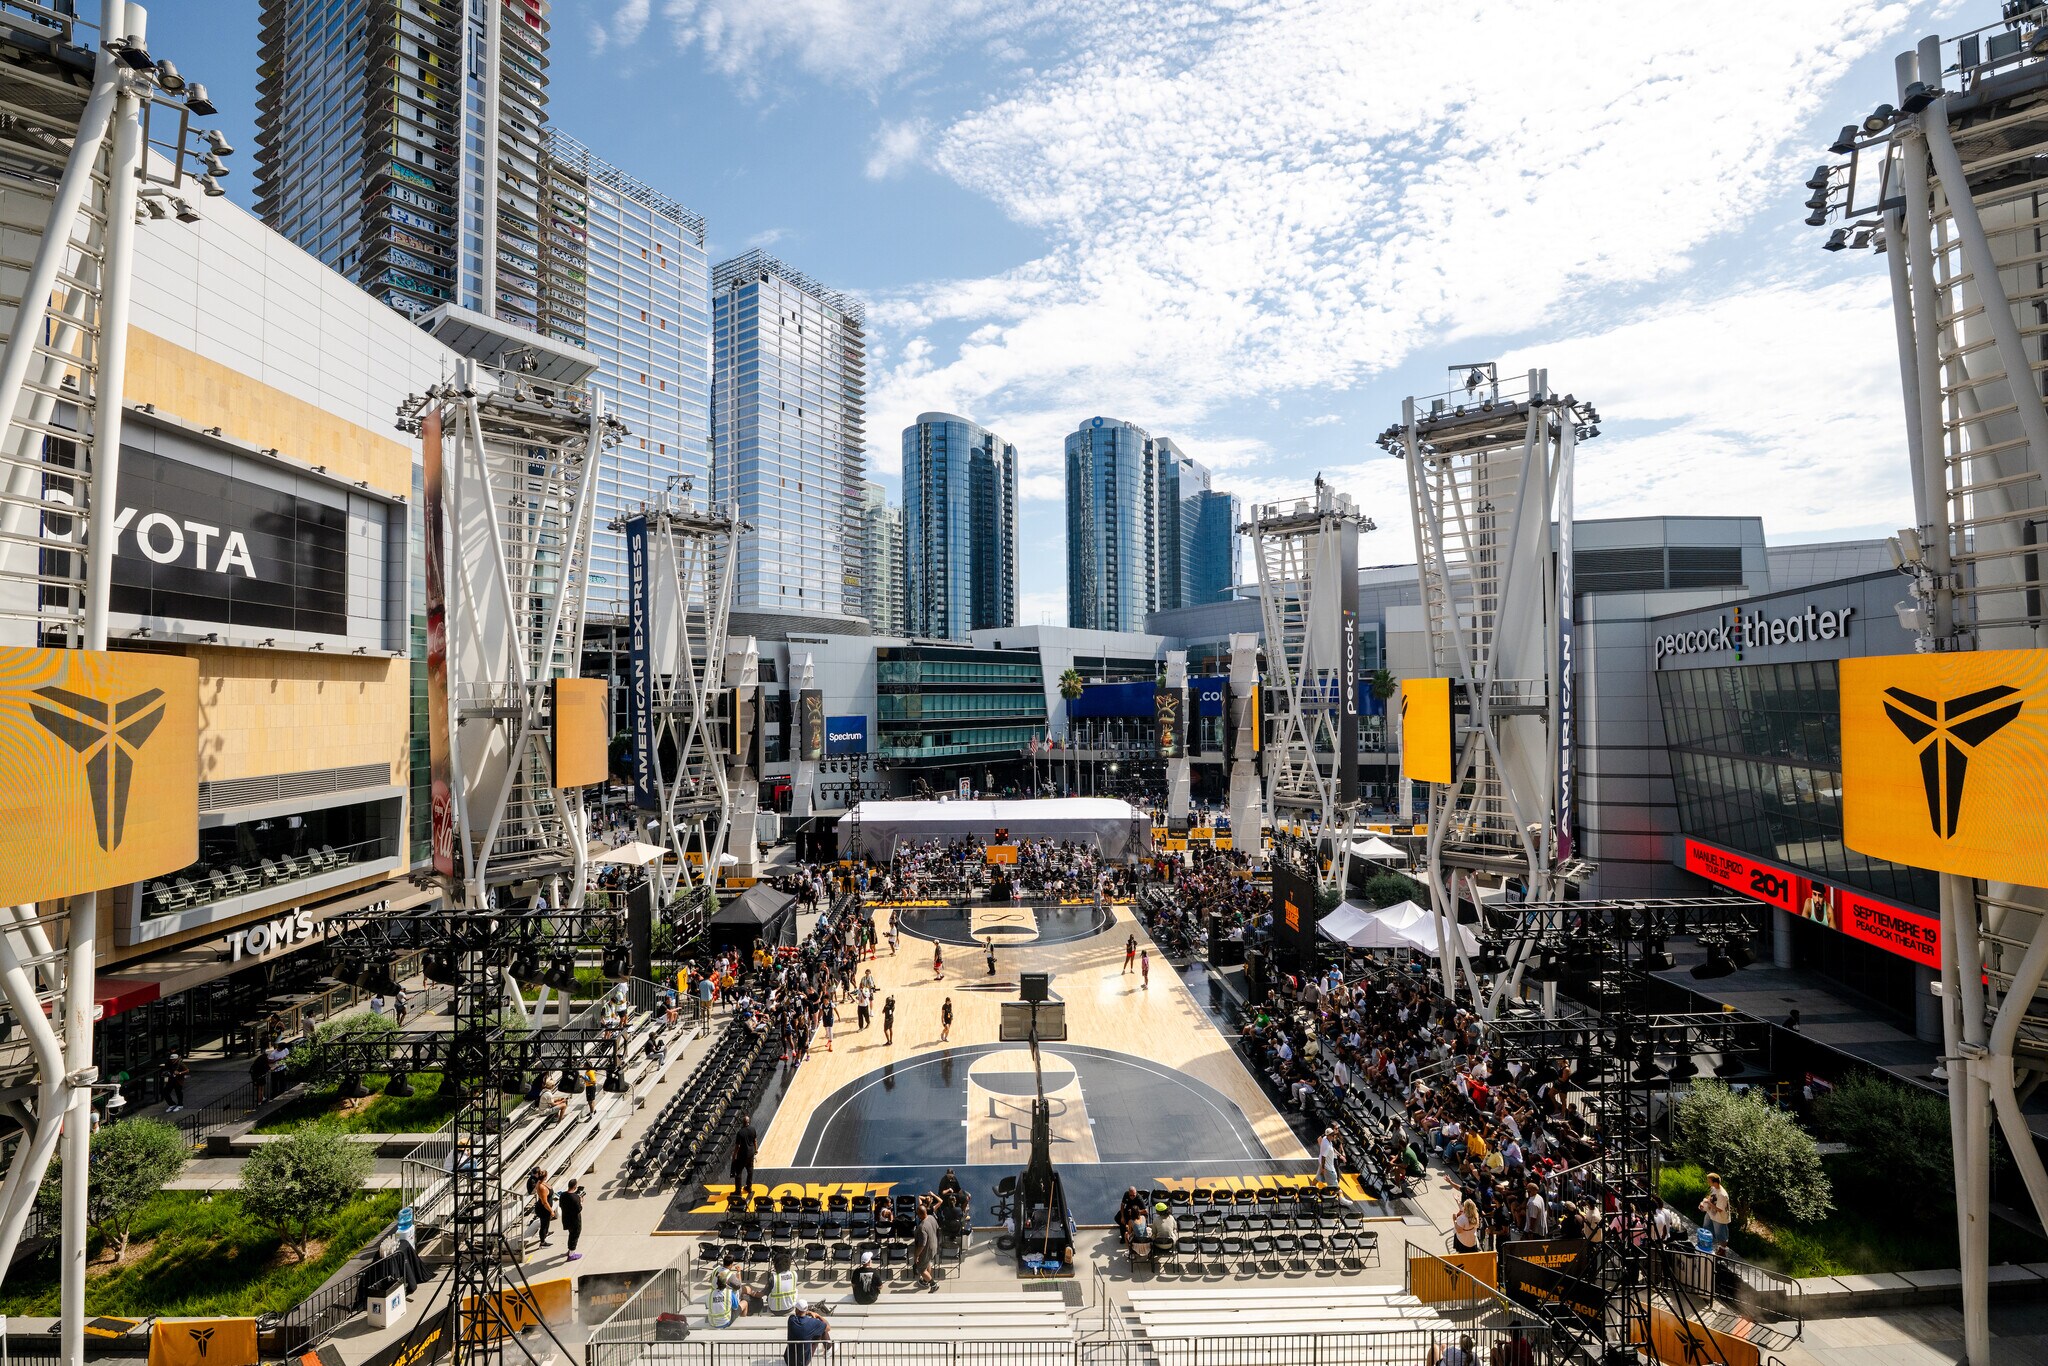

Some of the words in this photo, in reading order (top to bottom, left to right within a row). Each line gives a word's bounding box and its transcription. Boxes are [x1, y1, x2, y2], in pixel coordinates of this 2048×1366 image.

[44, 489, 257, 579] OYOTA
[633, 533, 644, 651] EXPRESS
[1655, 615, 1733, 670] peacock
[1743, 605, 1851, 648] theater
[1345, 619, 1357, 715] peacock
[635, 659, 649, 794] AMERICAN
[829, 732, 862, 742] Spectrum
[1561, 633, 1572, 838] AMERICAN
[1693, 848, 1719, 866] MANUEL
[1719, 856, 1743, 875] TURIZO
[1705, 863, 1719, 874] TOUR
[1719, 869, 1730, 880] 2025
[1750, 868, 1788, 903] 201
[368, 899, 391, 912] BAR
[1853, 904, 1920, 939] SEPTIEMBRE
[1922, 927, 1937, 944] 19
[226, 906, 314, 962] TOM'S
[1856, 920, 1892, 940] PEACOCK
[1894, 933, 1935, 956] THEATER
[1521, 1254, 1546, 1264] AMBA
[591, 1292, 628, 1306] MAMBA
